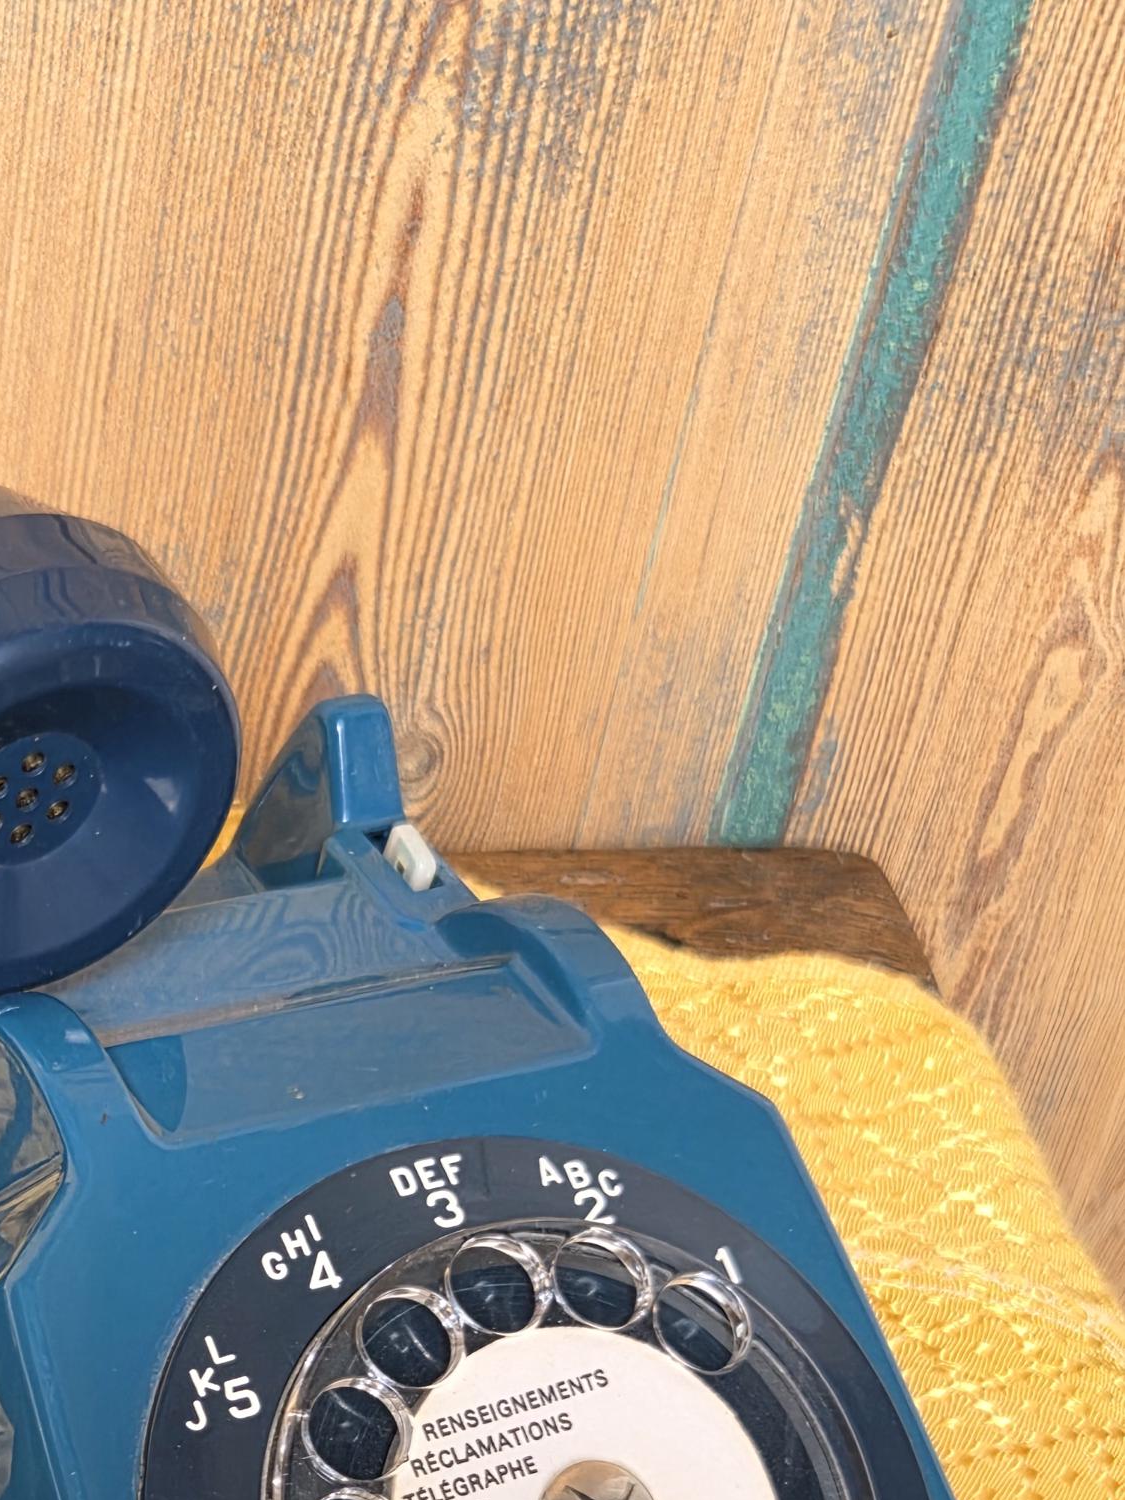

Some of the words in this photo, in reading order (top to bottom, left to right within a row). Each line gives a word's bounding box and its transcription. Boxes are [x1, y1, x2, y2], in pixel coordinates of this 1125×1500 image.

[389, 1154, 462, 1197] DEF
[539, 1156, 624, 1198] ABC
[426, 1190, 466, 1229] 3
[574, 1188, 617, 1225] 2
[261, 1214, 323, 1280] GHI
[715, 1246, 743, 1284] 1
[309, 1250, 343, 1290] 4
[224, 1375, 262, 1419] 5
[422, 1369, 609, 1442] RENSEIGNEMENTS
[410, 1412, 574, 1478] RÉCLAMATIONS
